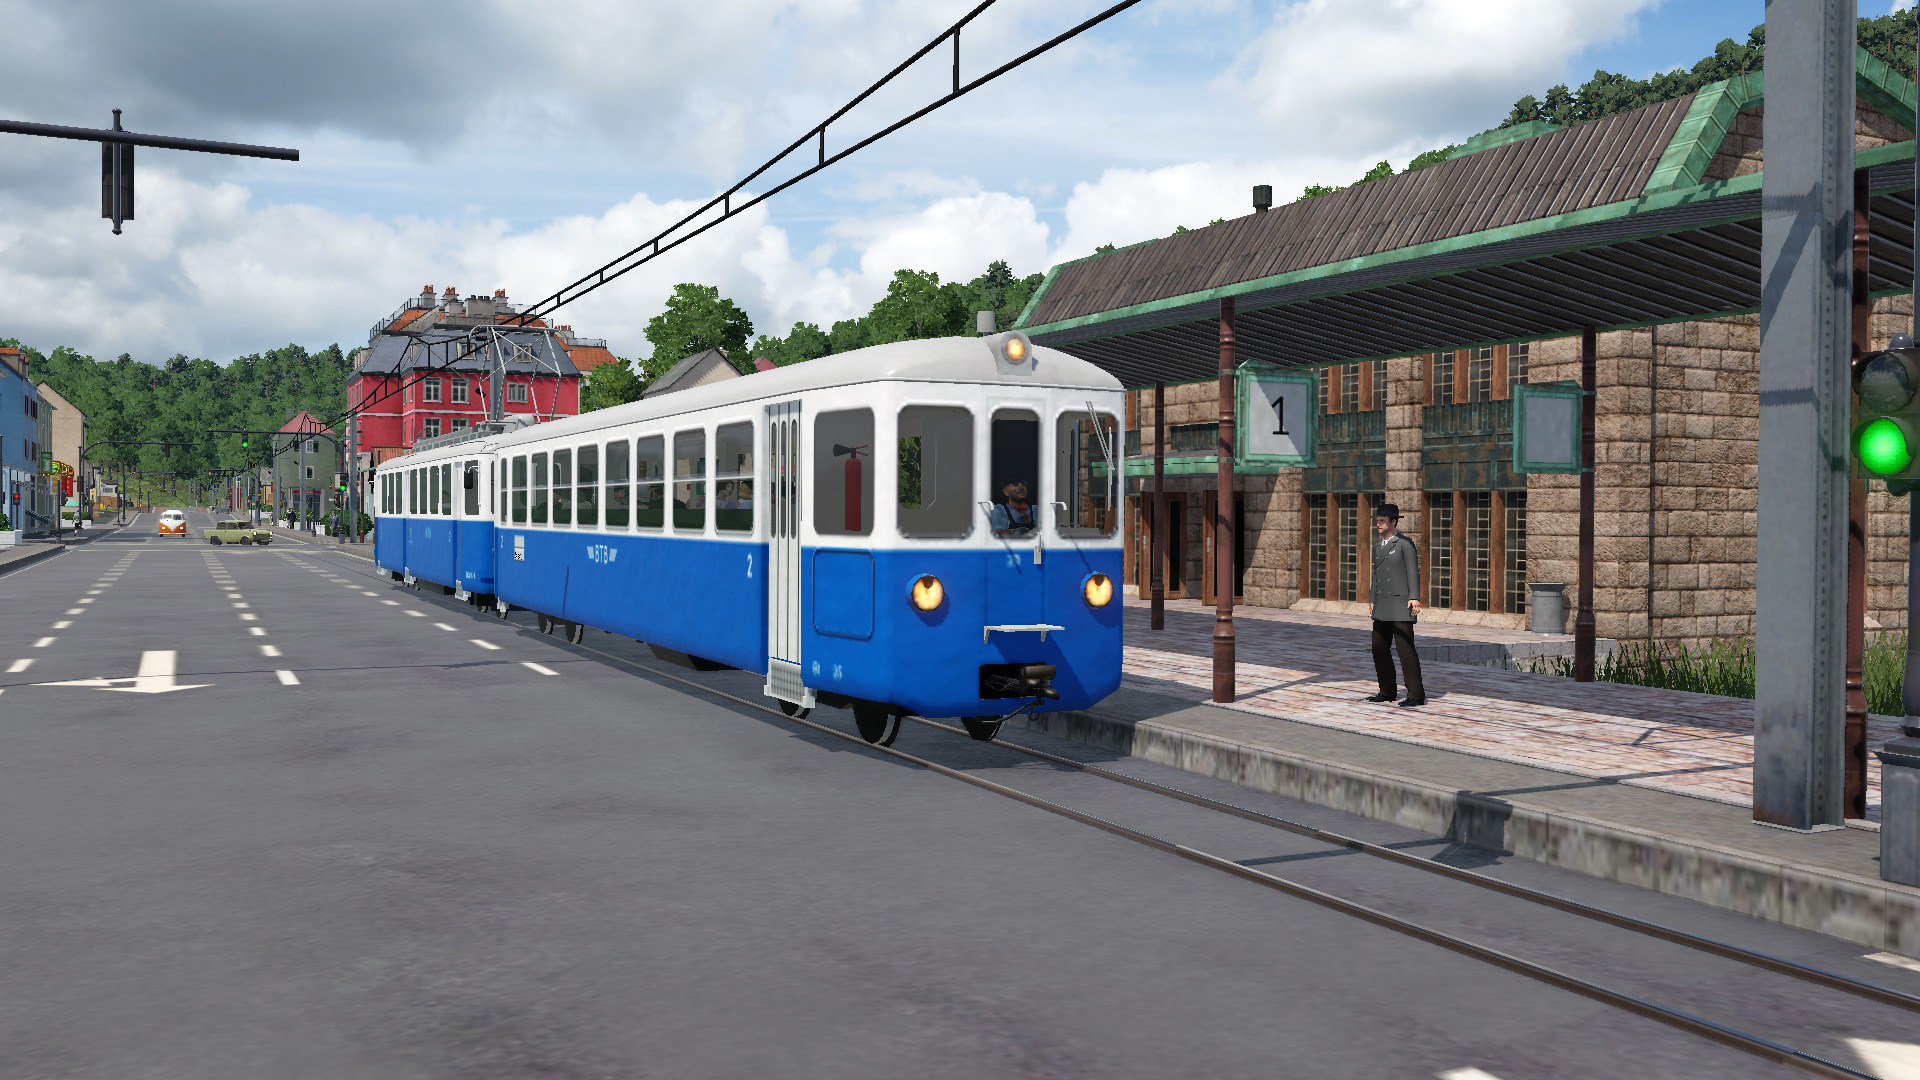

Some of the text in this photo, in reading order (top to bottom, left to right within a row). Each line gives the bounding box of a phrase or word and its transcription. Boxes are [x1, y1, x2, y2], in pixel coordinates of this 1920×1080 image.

[1271, 395, 1289, 435] 1
[595, 544, 608, 564] BTB
[747, 552, 753, 579] 2
